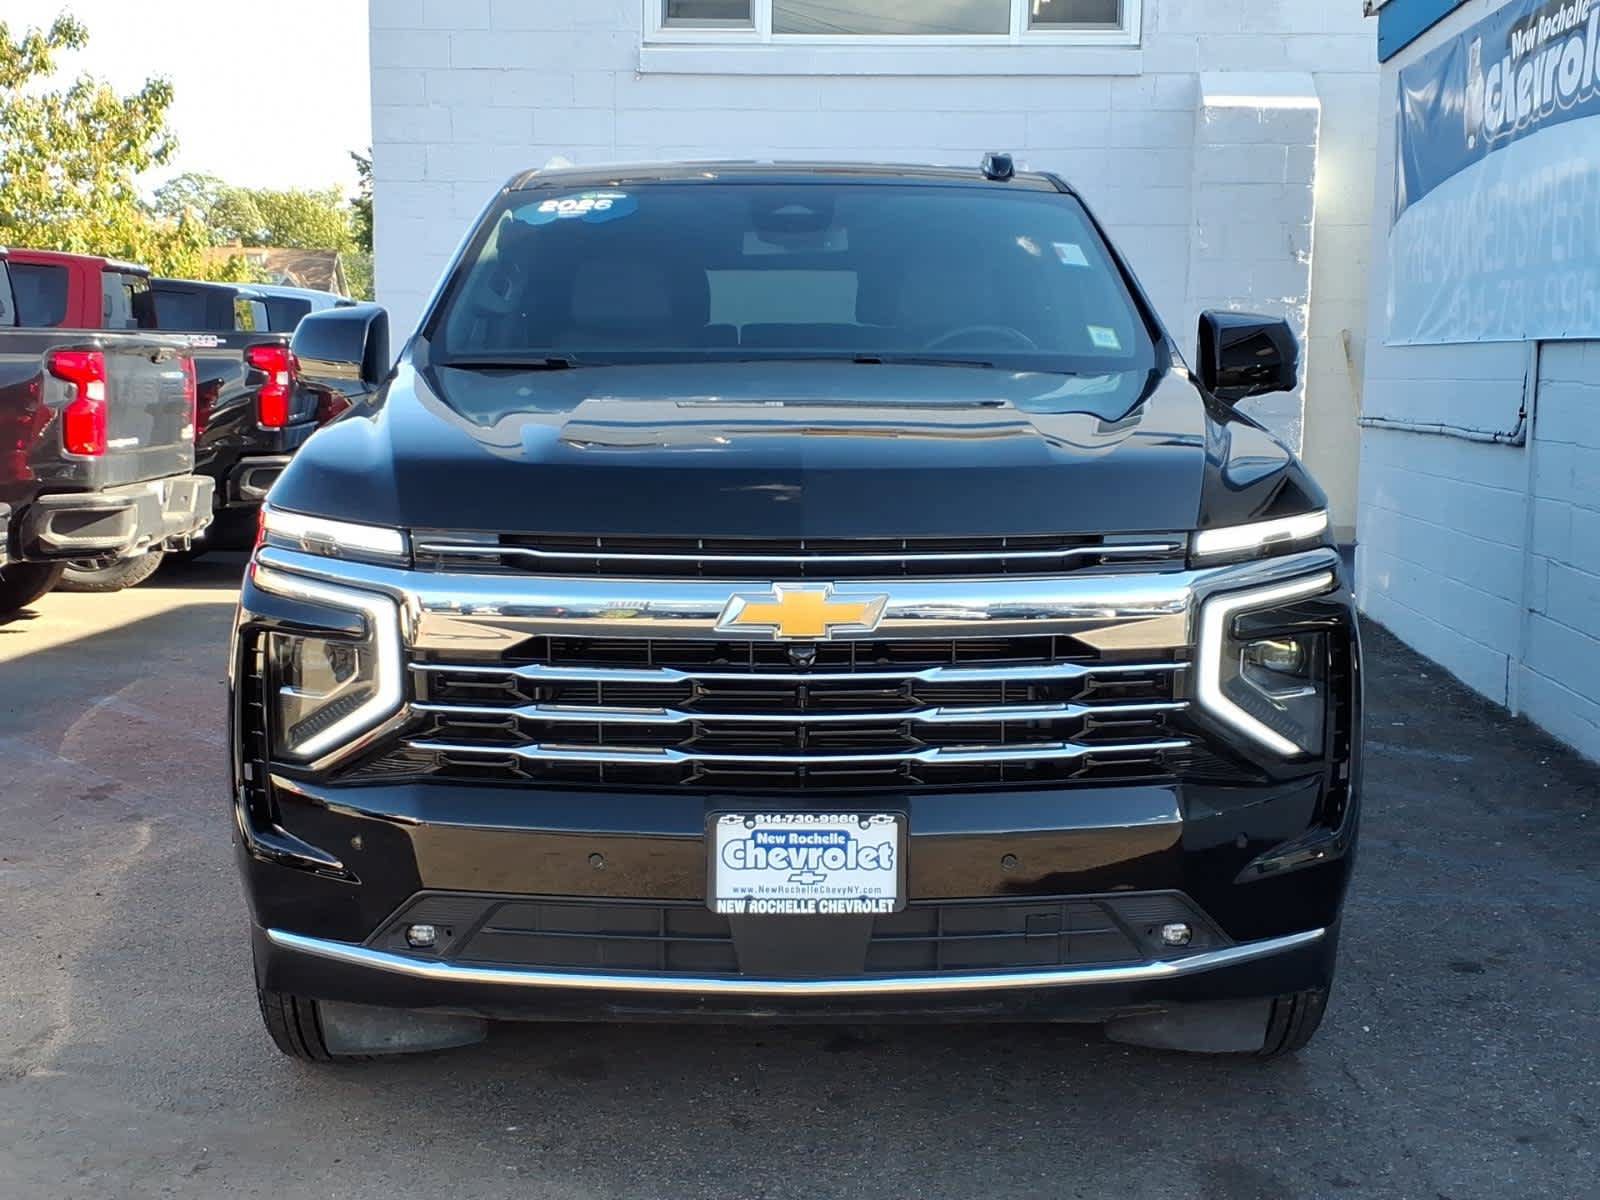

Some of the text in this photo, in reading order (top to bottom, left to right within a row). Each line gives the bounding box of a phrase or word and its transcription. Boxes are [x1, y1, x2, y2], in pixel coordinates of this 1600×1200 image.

[1511, 0, 1590, 60] New Rochelle
[1484, 6, 1600, 131] Chevrol
[754, 814, 859, 825] 914-730-9960
[756, 832, 846, 845] New Rochelle
[722, 839, 894, 871] Chevrolet
[732, 885, 882, 895] www.NewRochelleChevyNY.com
[717, 899, 896, 914] NEW ROCHELLE CHEVROLET
